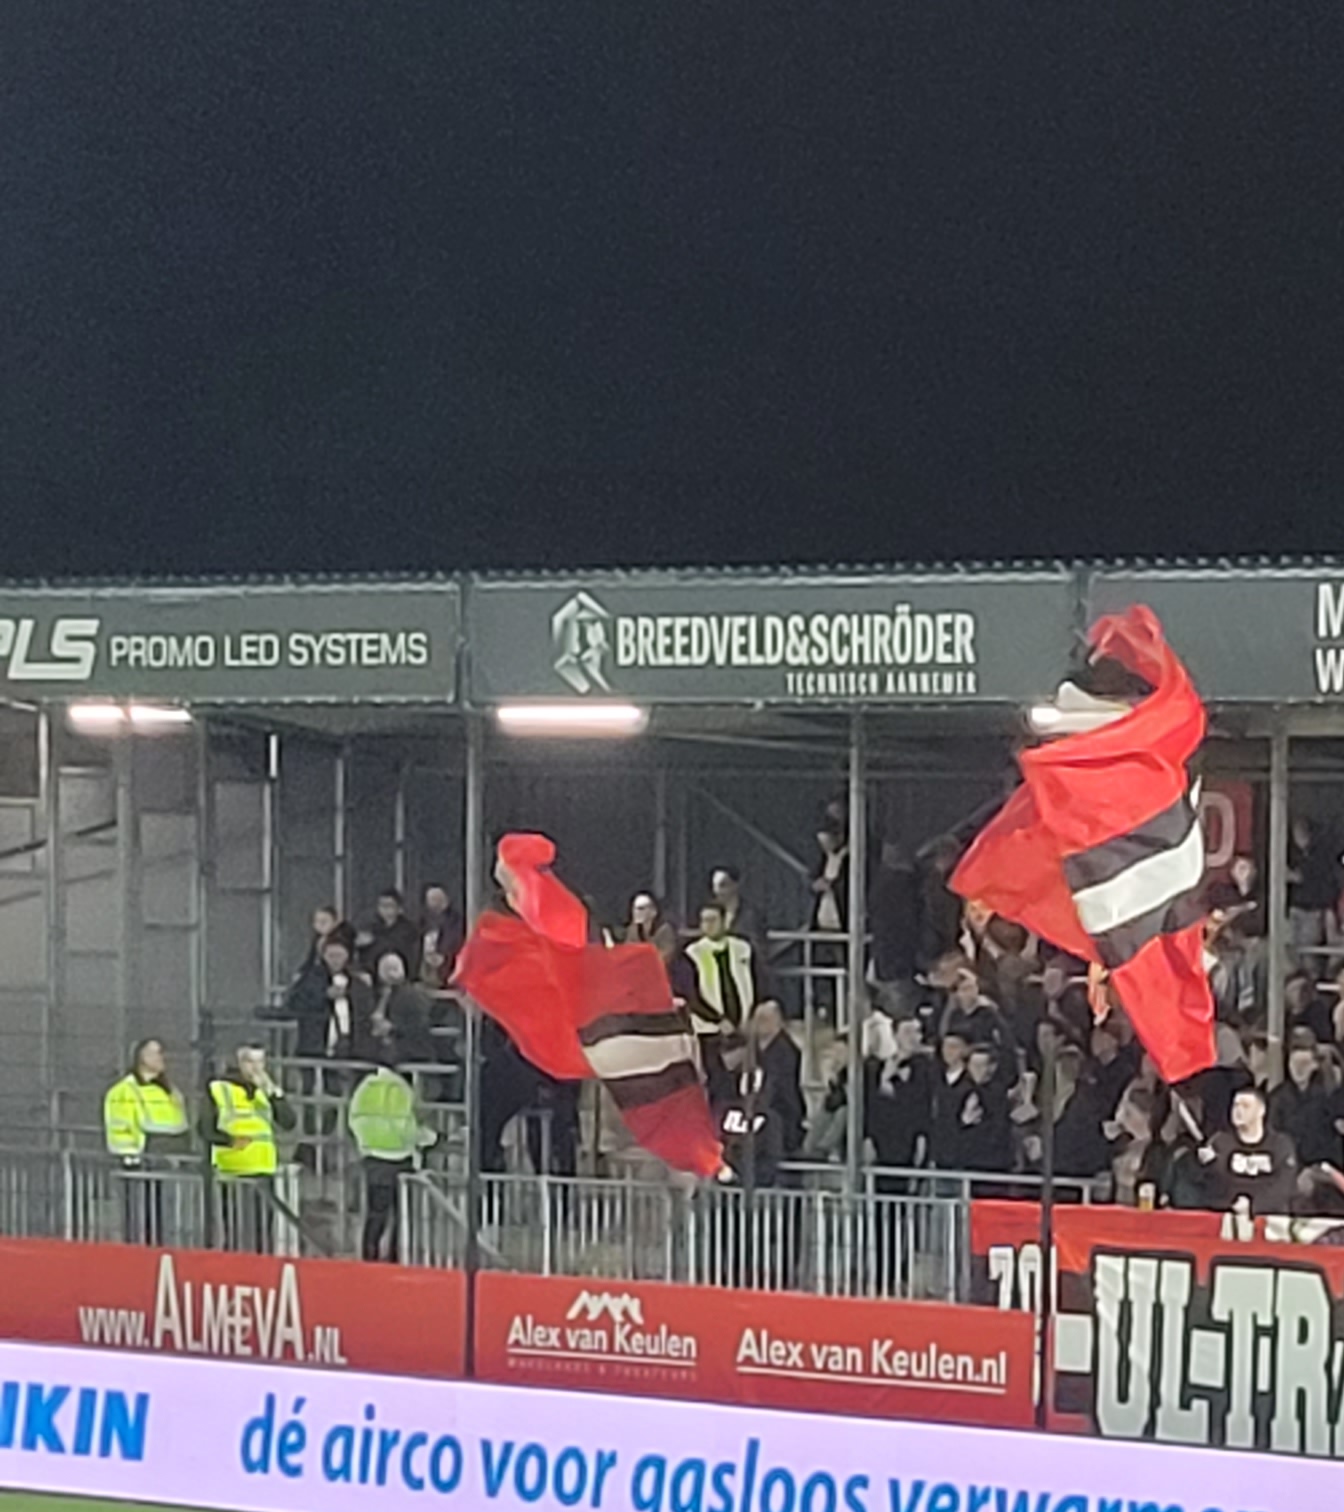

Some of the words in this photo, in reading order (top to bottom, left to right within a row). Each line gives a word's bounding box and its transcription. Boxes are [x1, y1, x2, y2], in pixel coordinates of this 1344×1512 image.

[109, 635, 216, 668] PROMO
[224, 635, 280, 667] LED
[288, 632, 428, 665] SYSTEMS
[615, 605, 977, 666] BREEDVELD&SCHRÖDER
[507, 1314, 560, 1348] Alex
[566, 1327, 608, 1352] van
[614, 1322, 697, 1359] Keulen
[736, 1327, 803, 1370] Alex
[810, 1344, 866, 1374] van
[871, 1339, 1007, 1385] Keulen.nl
[240, 1393, 306, 1477] dé
[321, 1403, 464, 1493] airco
[481, 1437, 617, 1509] voor
